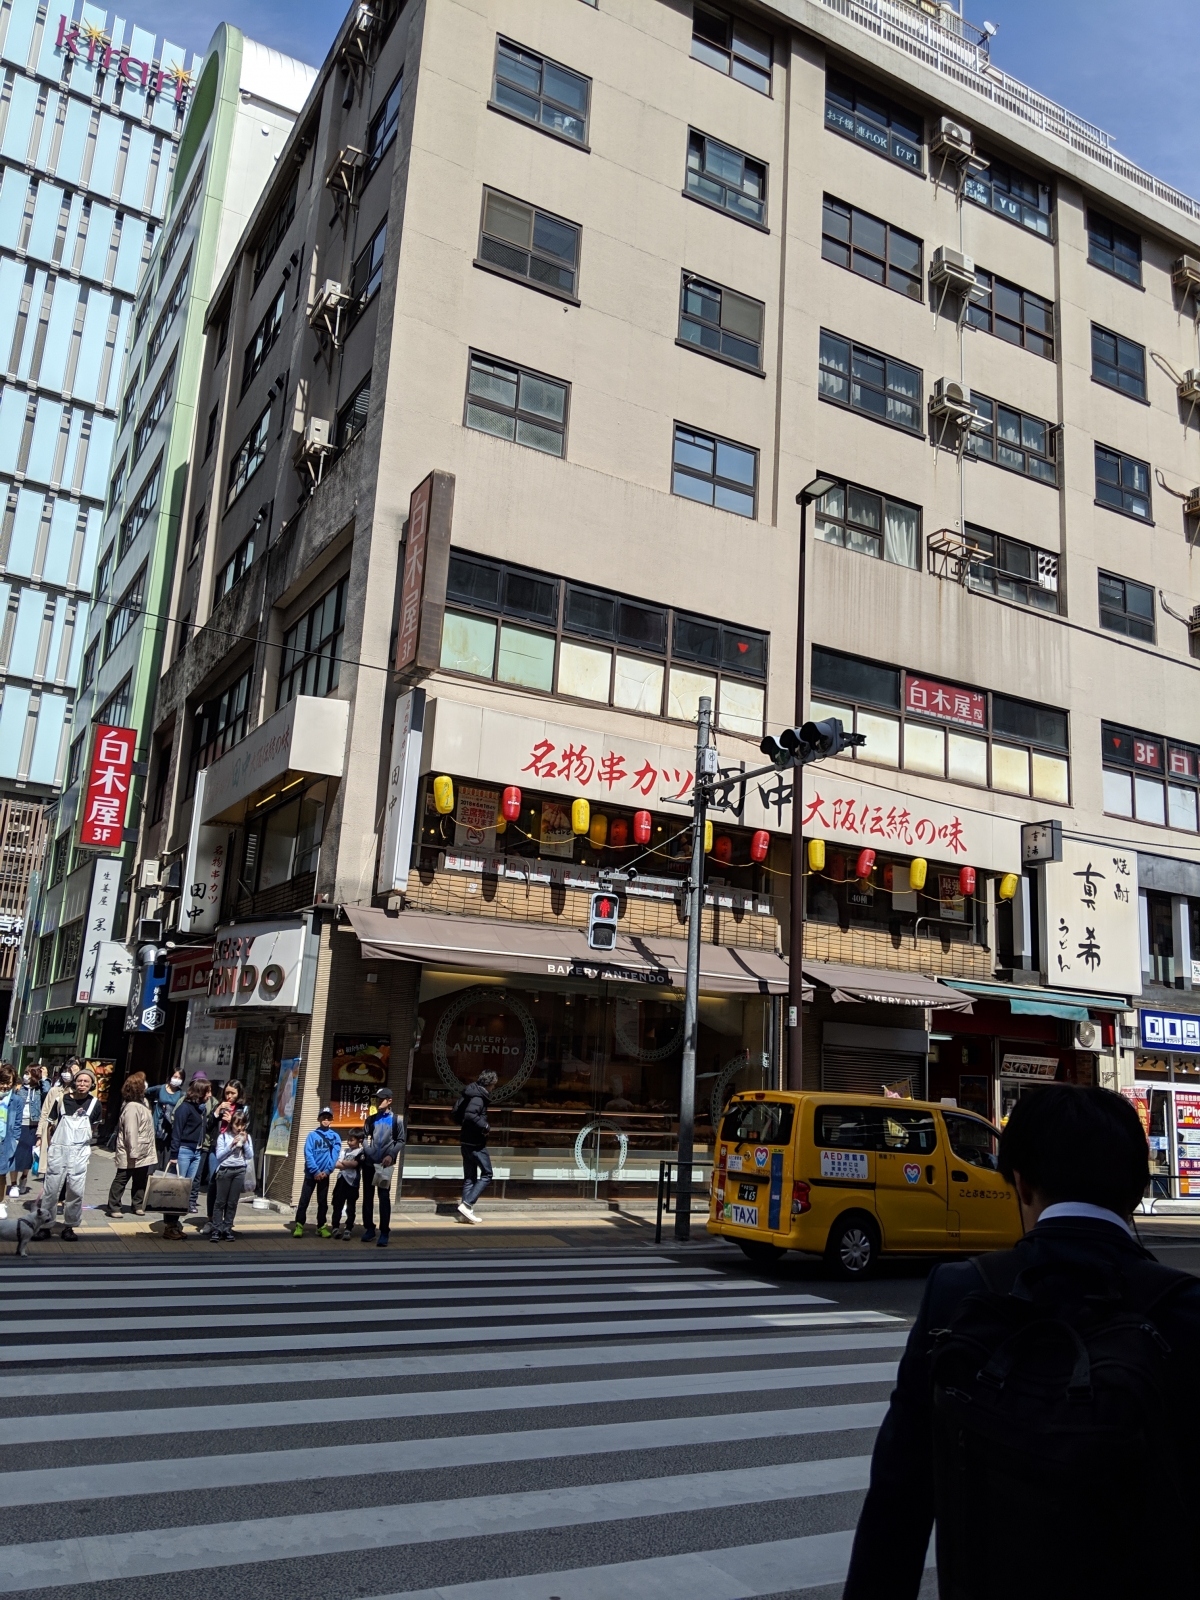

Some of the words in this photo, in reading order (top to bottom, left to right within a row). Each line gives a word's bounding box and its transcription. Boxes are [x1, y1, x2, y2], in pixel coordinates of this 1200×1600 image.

[55, 13, 196, 103] kirari
[400, 493, 428, 639] 白木屋
[402, 638, 413, 662] 3F
[910, 680, 973, 719] 白木屋
[972, 691, 983, 702] 3F
[1136, 742, 1155, 764] 3F
[86, 730, 129, 827] 白木屋
[521, 738, 695, 800] 名物串カツ
[802, 790, 968, 855] 大阪伝統の味
[460, 806, 495, 820] 全席禁煙
[460, 816, 494, 827] となります
[92, 827, 112, 841] 3F
[207, 845, 224, 905] 名物串カツ
[185, 882, 207, 924] 田中
[1072, 862, 1106, 973] 真希
[1057, 917, 1071, 973] うどん
[547, 963, 600, 977] BAKERY
[604, 969, 665, 983] ANTENDO
[452, 1042, 520, 1055] ANTENDO
[466, 1034, 508, 1044] BAKERY
[353, 1084, 361, 1113] カレー
[959, 1189, 1012, 1200] ことぶきこうつう
[732, 1205, 757, 1225] TAXI
